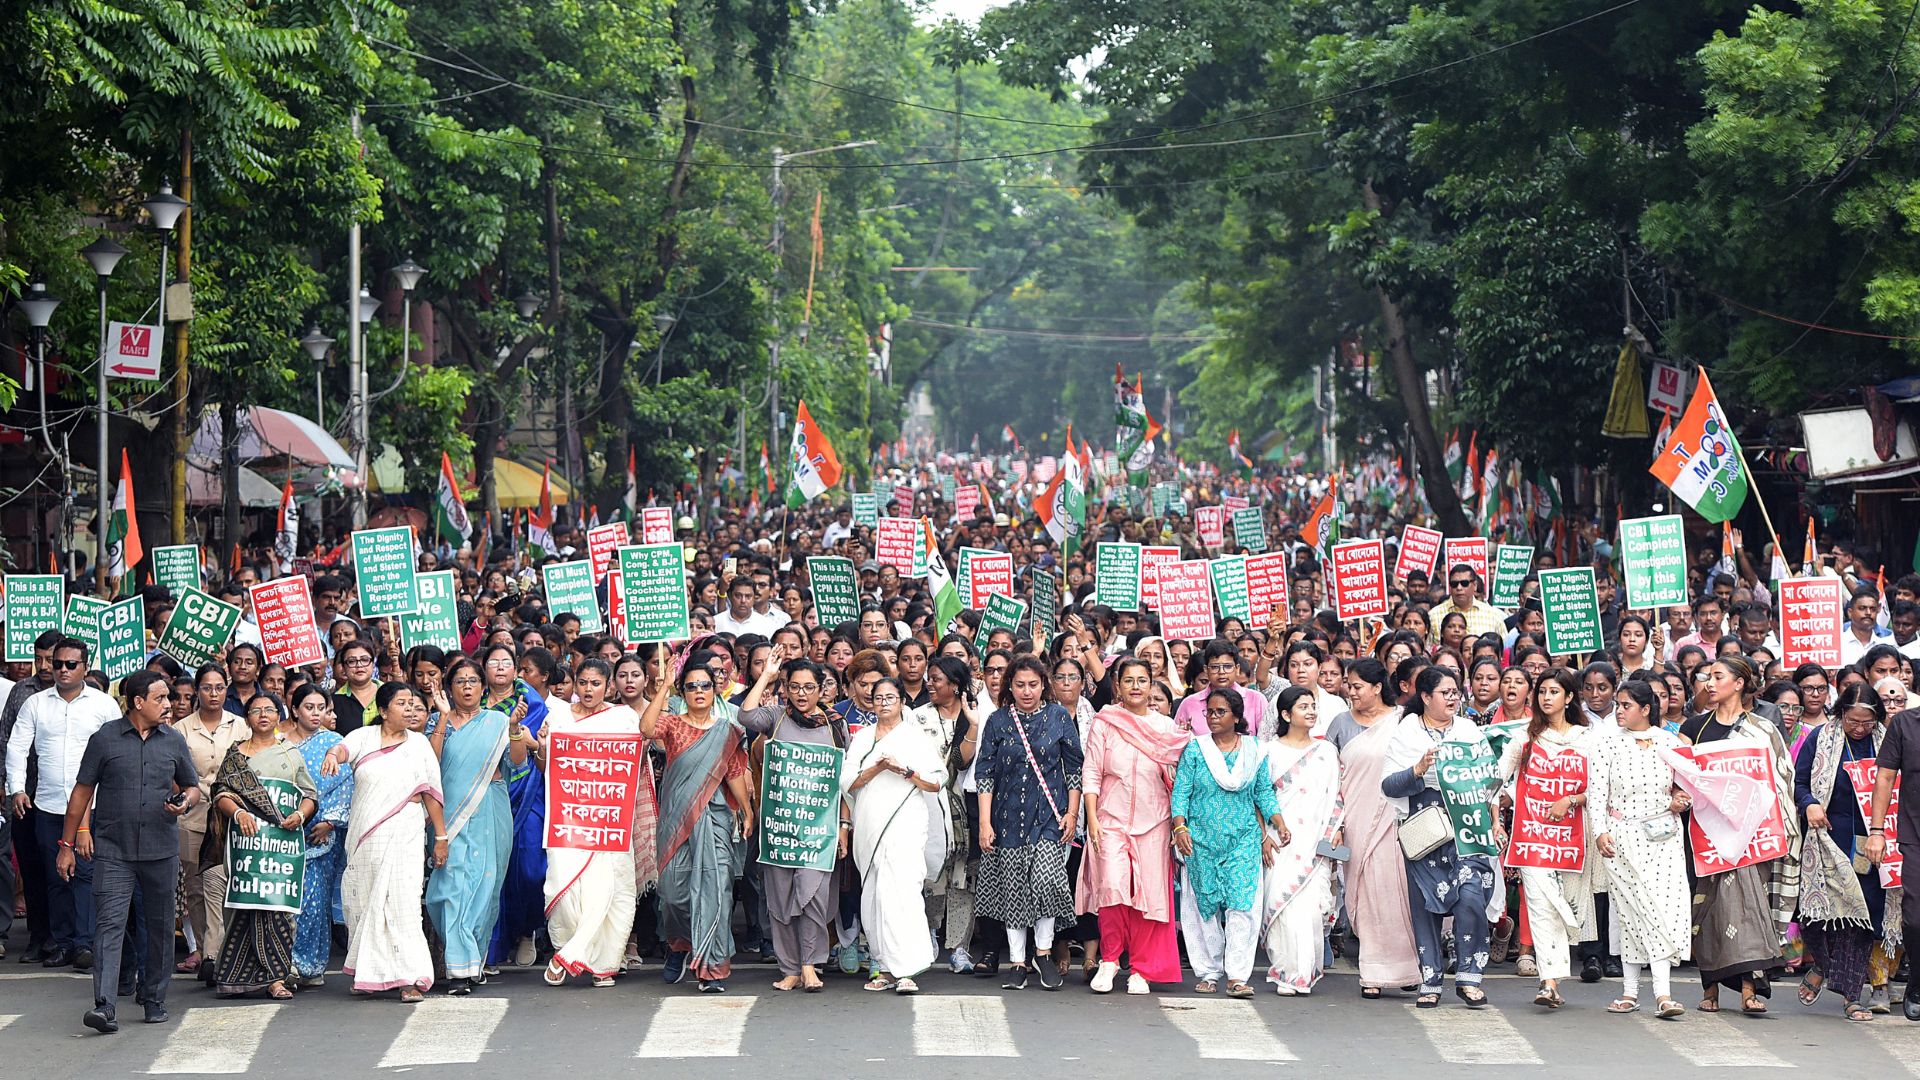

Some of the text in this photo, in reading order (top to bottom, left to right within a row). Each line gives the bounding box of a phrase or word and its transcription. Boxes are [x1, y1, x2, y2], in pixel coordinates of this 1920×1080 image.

[129, 330, 145, 346] V
[122, 345, 148, 356] MART
[1628, 522, 1677, 538] CBI Must
[360, 533, 404, 545] The Dignity
[1628, 537, 1680, 552] Complete
[171, 550, 193, 559] Dignity
[359, 543, 407, 554] and Respect
[630, 549, 673, 562] Why CPM,
[1336, 546, 1379, 562] মা বোনেদের
[1502, 550, 1515, 559] CBI
[169, 557, 195, 566] Respect
[363, 552, 405, 564] of Mothers
[625, 558, 678, 569] Cong. & BJP
[1628, 554, 1681, 569] Investigation
[363, 562, 407, 573] and Sisters
[549, 565, 588, 581] CBI Must
[625, 567, 680, 578] are SILENT
[812, 562, 828, 571] This
[842, 563, 853, 574] Big
[1337, 560, 1379, 574] সম্মান
[372, 572, 400, 582] are the
[631, 577, 677, 587] regarding
[813, 574, 850, 585] Conspiracy
[973, 572, 1008, 583] সম্মান
[1341, 573, 1379, 587] আমাদের
[1546, 573, 1589, 584] The Dignity
[1637, 571, 1676, 588] by this
[9, 582, 60, 593] This is a Big
[365, 580, 409, 593] Dignity and
[550, 578, 590, 593] Complete
[625, 585, 684, 595] Coochbehar,
[816, 584, 855, 596] CPM & BJP,
[1562, 583, 1592, 593] Respect
[1784, 584, 1837, 600] মা বোনেদের
[9, 594, 54, 606] Conspiracy
[369, 591, 408, 602] Respect
[550, 591, 593, 606] Investigation
[629, 595, 680, 604] Bantala,
[818, 595, 856, 606] Listen,
[1344, 587, 1378, 601] সকলের
[1550, 592, 1590, 602] of Mothers
[1632, 588, 1684, 602] Sunday
[11, 607, 58, 618] CPM & BJP,
[76, 601, 88, 612] We
[371, 600, 408, 612] of All
[629, 602, 682, 612] Dhantala,
[820, 605, 857, 616] We Will
[992, 597, 1017, 614] We will
[1341, 599, 1383, 613] সম্মান
[1550, 602, 1592, 612] and Sisters
[1784, 600, 1838, 616] সম্মান
[101, 603, 140, 631] CBI,
[183, 594, 229, 632] CBI,
[630, 610, 683, 621] Hathras,
[986, 607, 1017, 627] Combat
[1559, 611, 1586, 621] are the
[10, 619, 59, 630] Listen,
[65, 625, 77, 636] the
[185, 616, 214, 639] We
[407, 616, 451, 633] Want
[635, 620, 679, 629] Unnao,
[1552, 620, 1594, 631] Dignity and
[1788, 617, 1834, 632] আমাদের
[11, 631, 31, 642] We
[109, 628, 133, 644] We
[631, 628, 663, 638] Gujrat
[1556, 630, 1594, 640] Respect
[171, 627, 215, 655] Want
[1558, 641, 1567, 649] of
[1582, 639, 1594, 647] All
[1791, 634, 1833, 648] সকলের
[104, 640, 140, 660] Want
[1786, 649, 1839, 664] সম্মান
[105, 656, 144, 680] Justice
[554, 738, 639, 756] মা বোনেদের
[1438, 744, 1464, 761] We
[771, 744, 835, 766] The Dignity
[554, 757, 635, 777] সম্মান
[769, 760, 836, 779] and Respect
[1529, 753, 1584, 774] বোনেদের
[1442, 762, 1500, 784] Capita
[559, 778, 628, 800] আমাদের
[770, 775, 830, 793] of Mothers
[265, 786, 298, 810] Want
[769, 790, 829, 807] and Sisters
[561, 802, 622, 823] সকলের
[774, 806, 816, 821] are the
[1462, 809, 1482, 826] of
[765, 816, 827, 836] Dignity and
[1522, 819, 1573, 842] সকলের
[553, 824, 627, 845] সম্মান
[767, 833, 822, 849] Respect
[232, 831, 301, 856] Punishment
[769, 848, 819, 863] of us All
[1515, 841, 1581, 864] সম্মান
[235, 856, 294, 876] of the
[231, 876, 298, 898] Culprit
